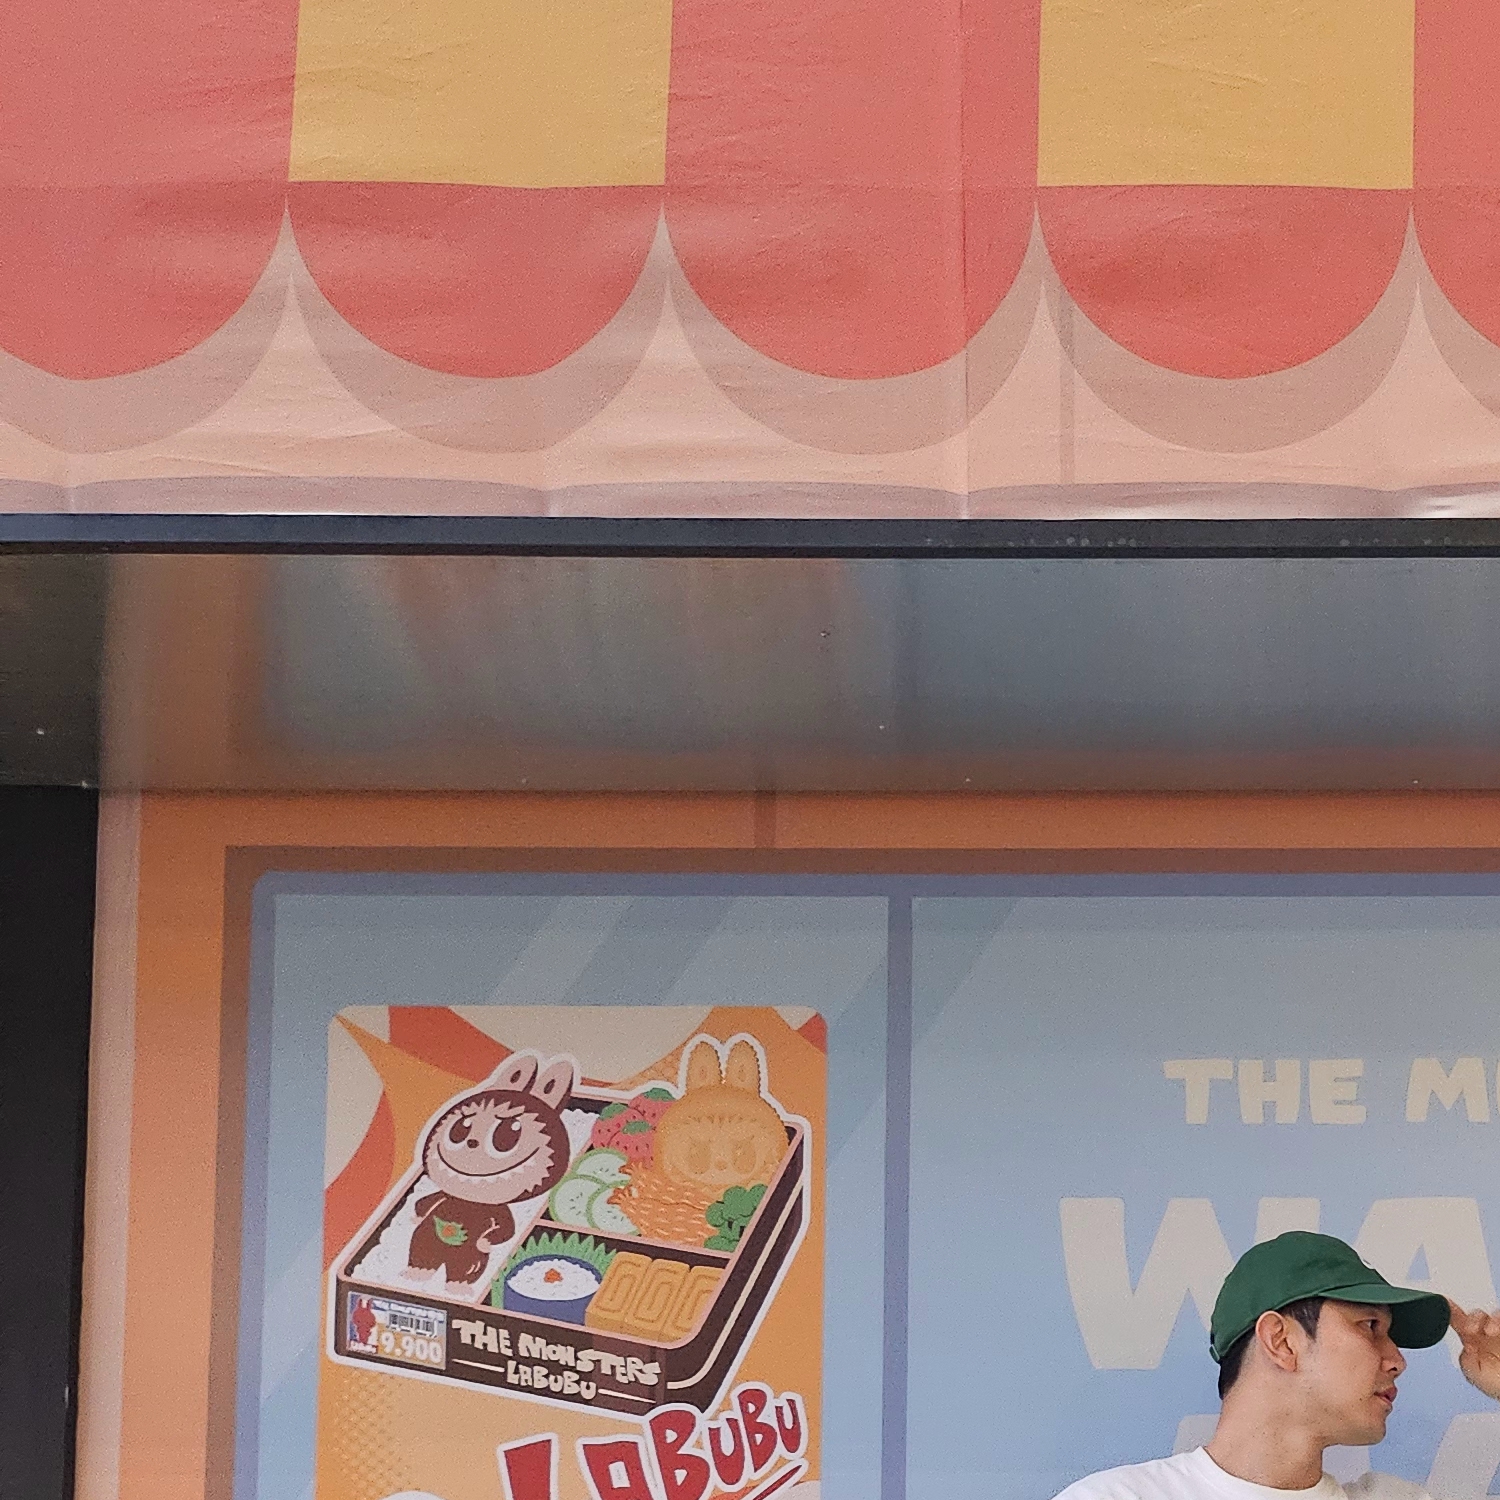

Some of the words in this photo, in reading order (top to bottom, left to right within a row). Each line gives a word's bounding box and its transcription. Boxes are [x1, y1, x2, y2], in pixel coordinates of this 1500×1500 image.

[1164, 1058, 1368, 1125] THE
[451, 1318, 513, 1357] THE
[518, 1333, 662, 1386] MONSTERS
[505, 1360, 597, 1401] LABUBU
